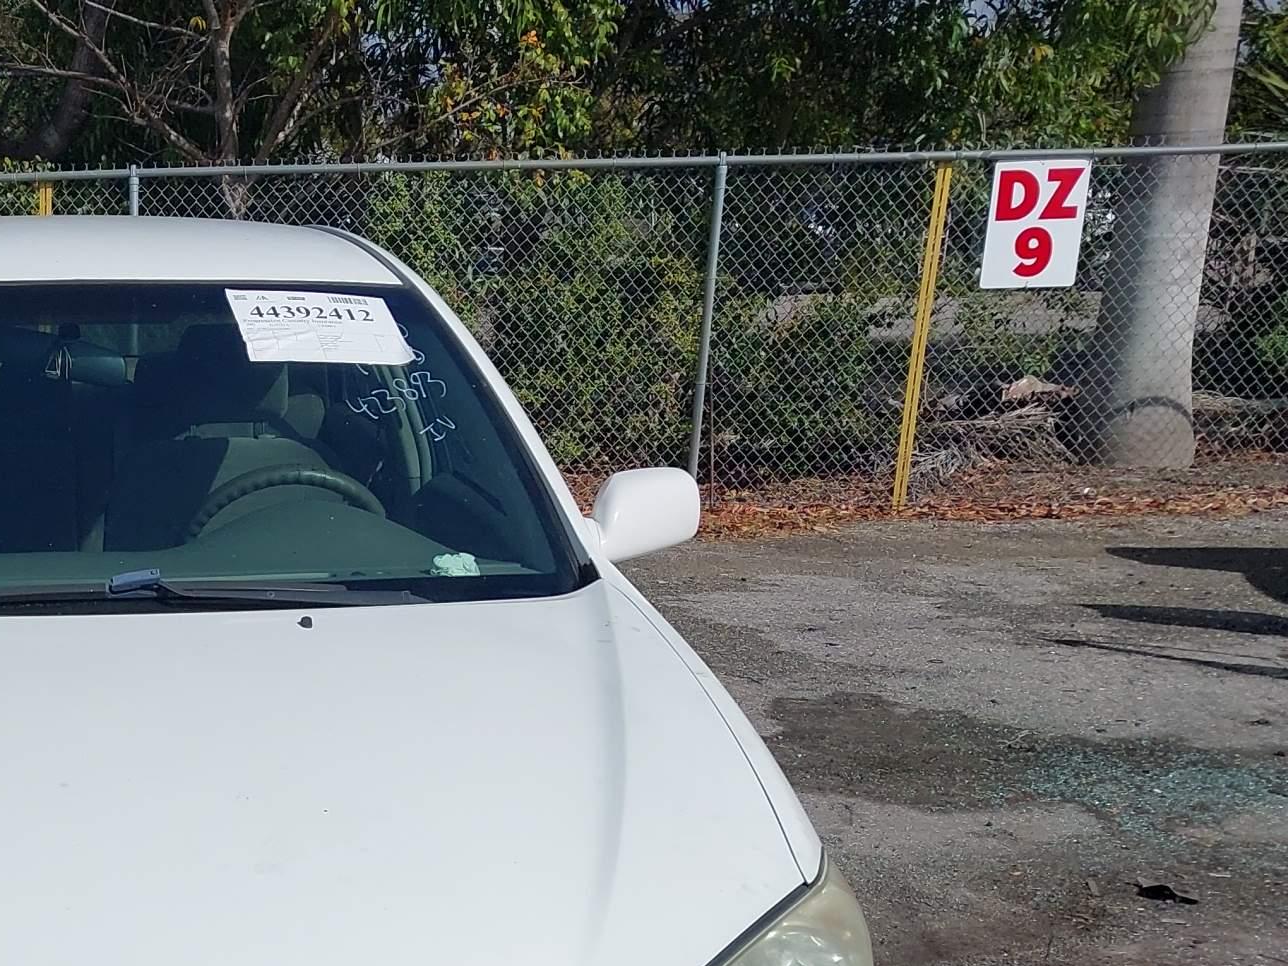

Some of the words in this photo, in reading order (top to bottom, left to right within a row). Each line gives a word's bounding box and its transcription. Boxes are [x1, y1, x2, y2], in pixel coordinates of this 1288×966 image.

[995, 167, 1087, 222] DZ
[1012, 226, 1053, 278] 9
[250, 305, 374, 322] 44392412
